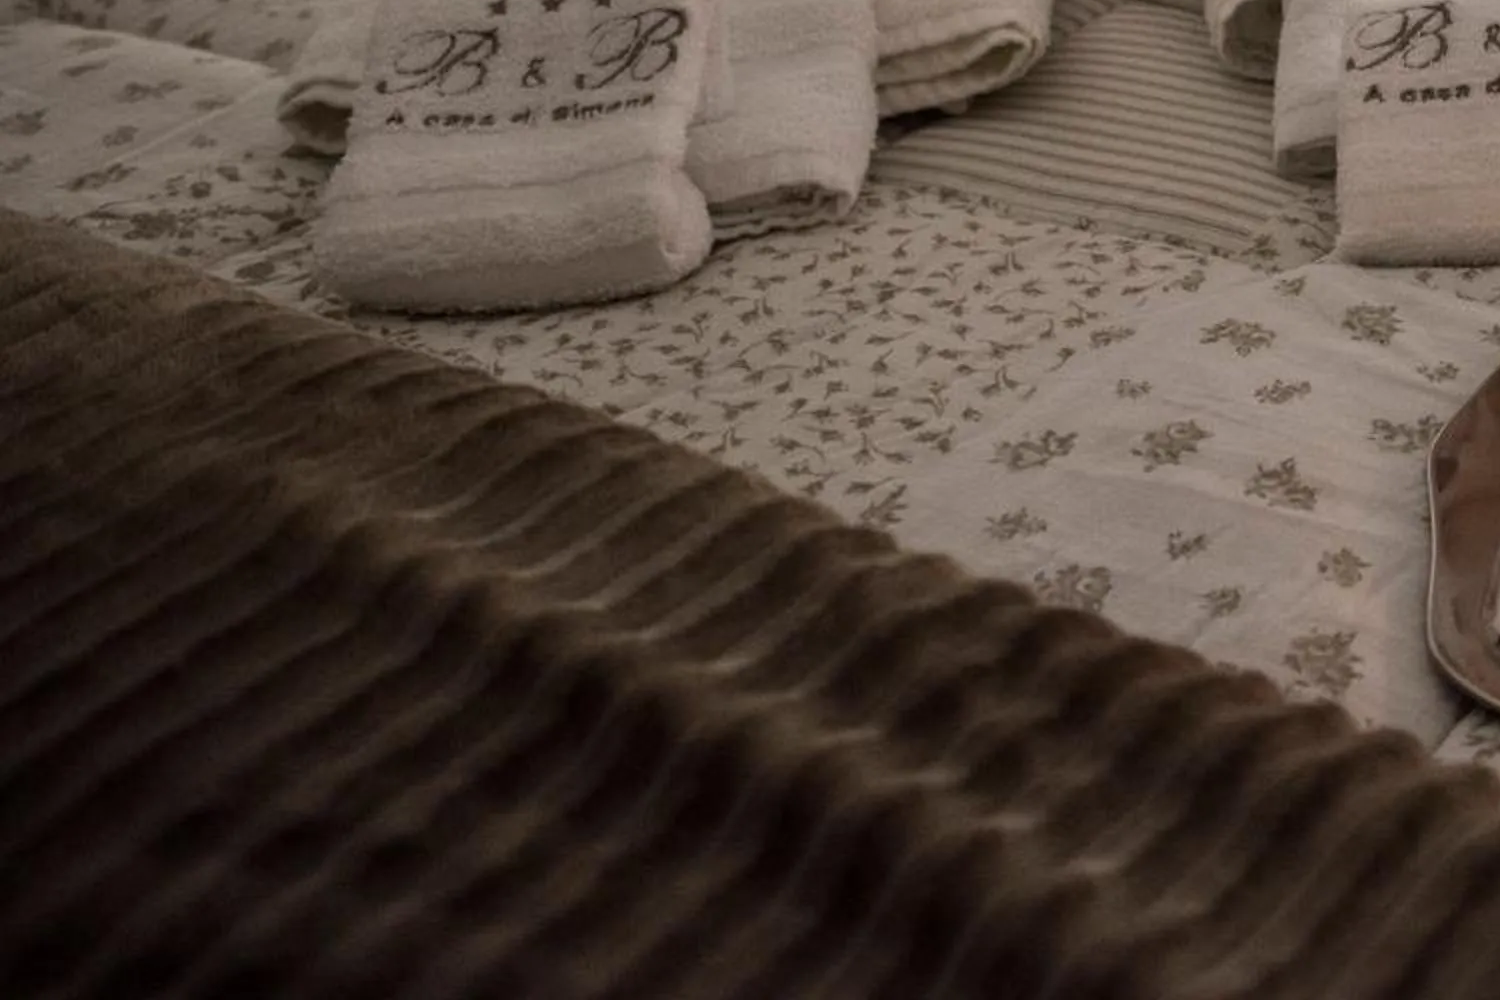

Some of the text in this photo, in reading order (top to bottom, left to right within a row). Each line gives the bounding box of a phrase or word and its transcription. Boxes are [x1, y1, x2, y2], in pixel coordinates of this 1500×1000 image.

[1346, 0, 1454, 70] B
[520, 57, 547, 88] &
[1363, 83, 1387, 103] A
